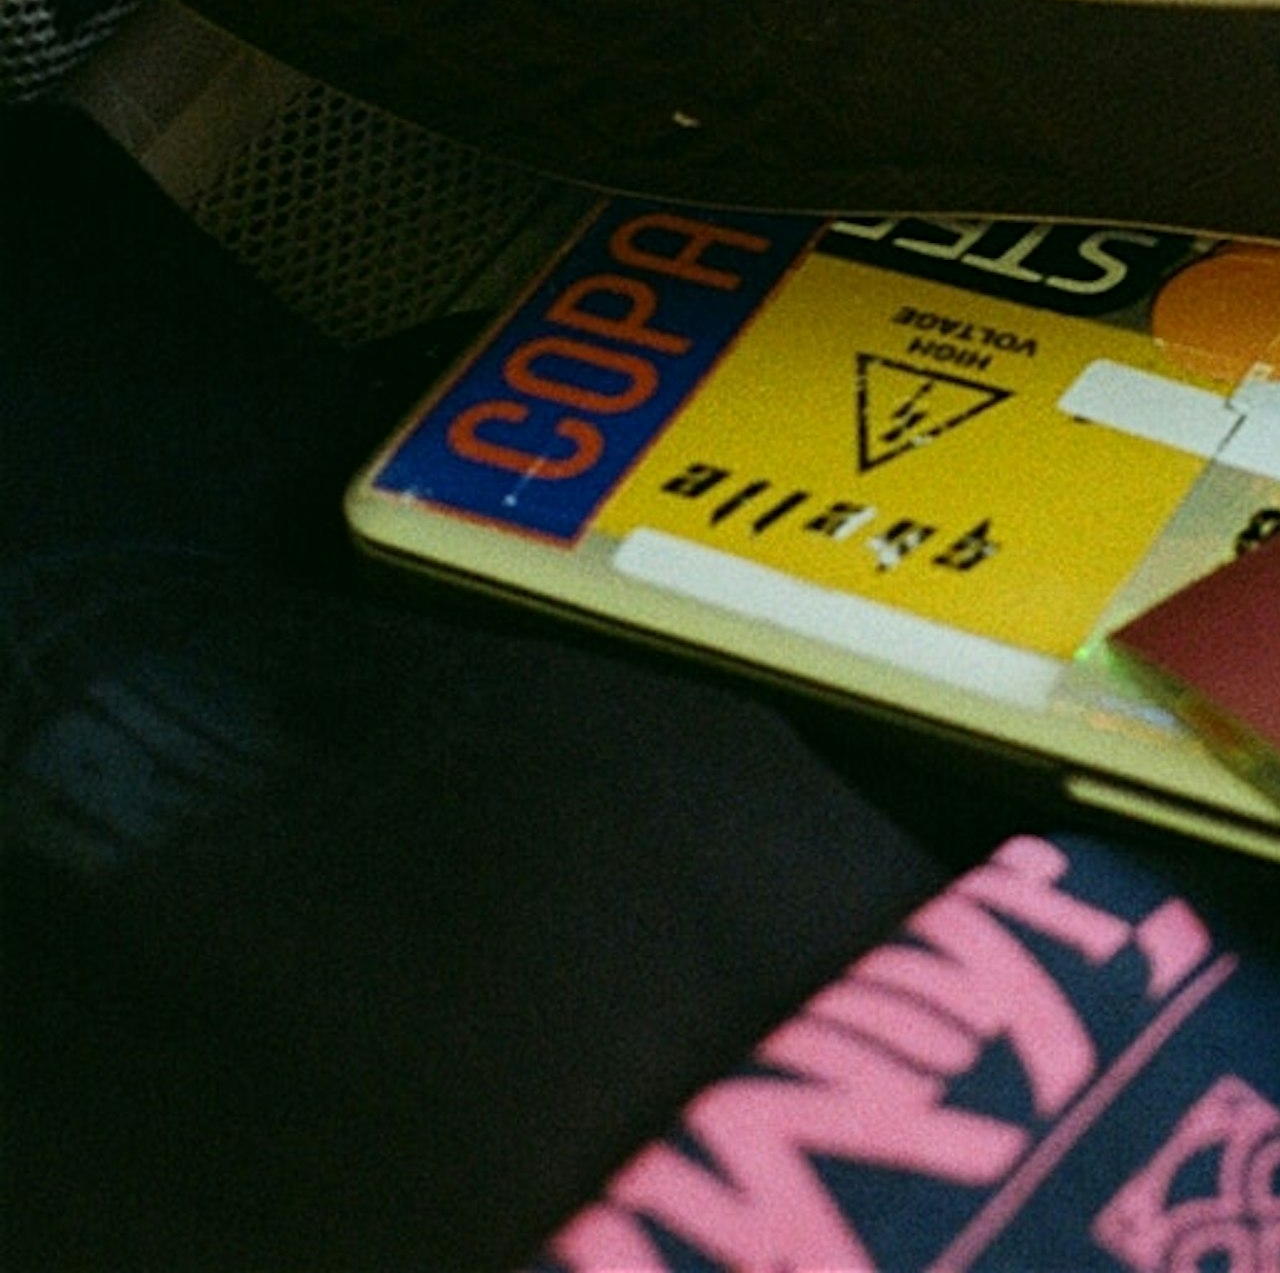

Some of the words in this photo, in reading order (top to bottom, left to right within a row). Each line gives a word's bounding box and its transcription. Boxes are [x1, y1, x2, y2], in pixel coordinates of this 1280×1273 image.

[446, 212, 773, 481] COPA
[894, 305, 1038, 358] VOLTAGE
[905, 336, 992, 370] HIGH
